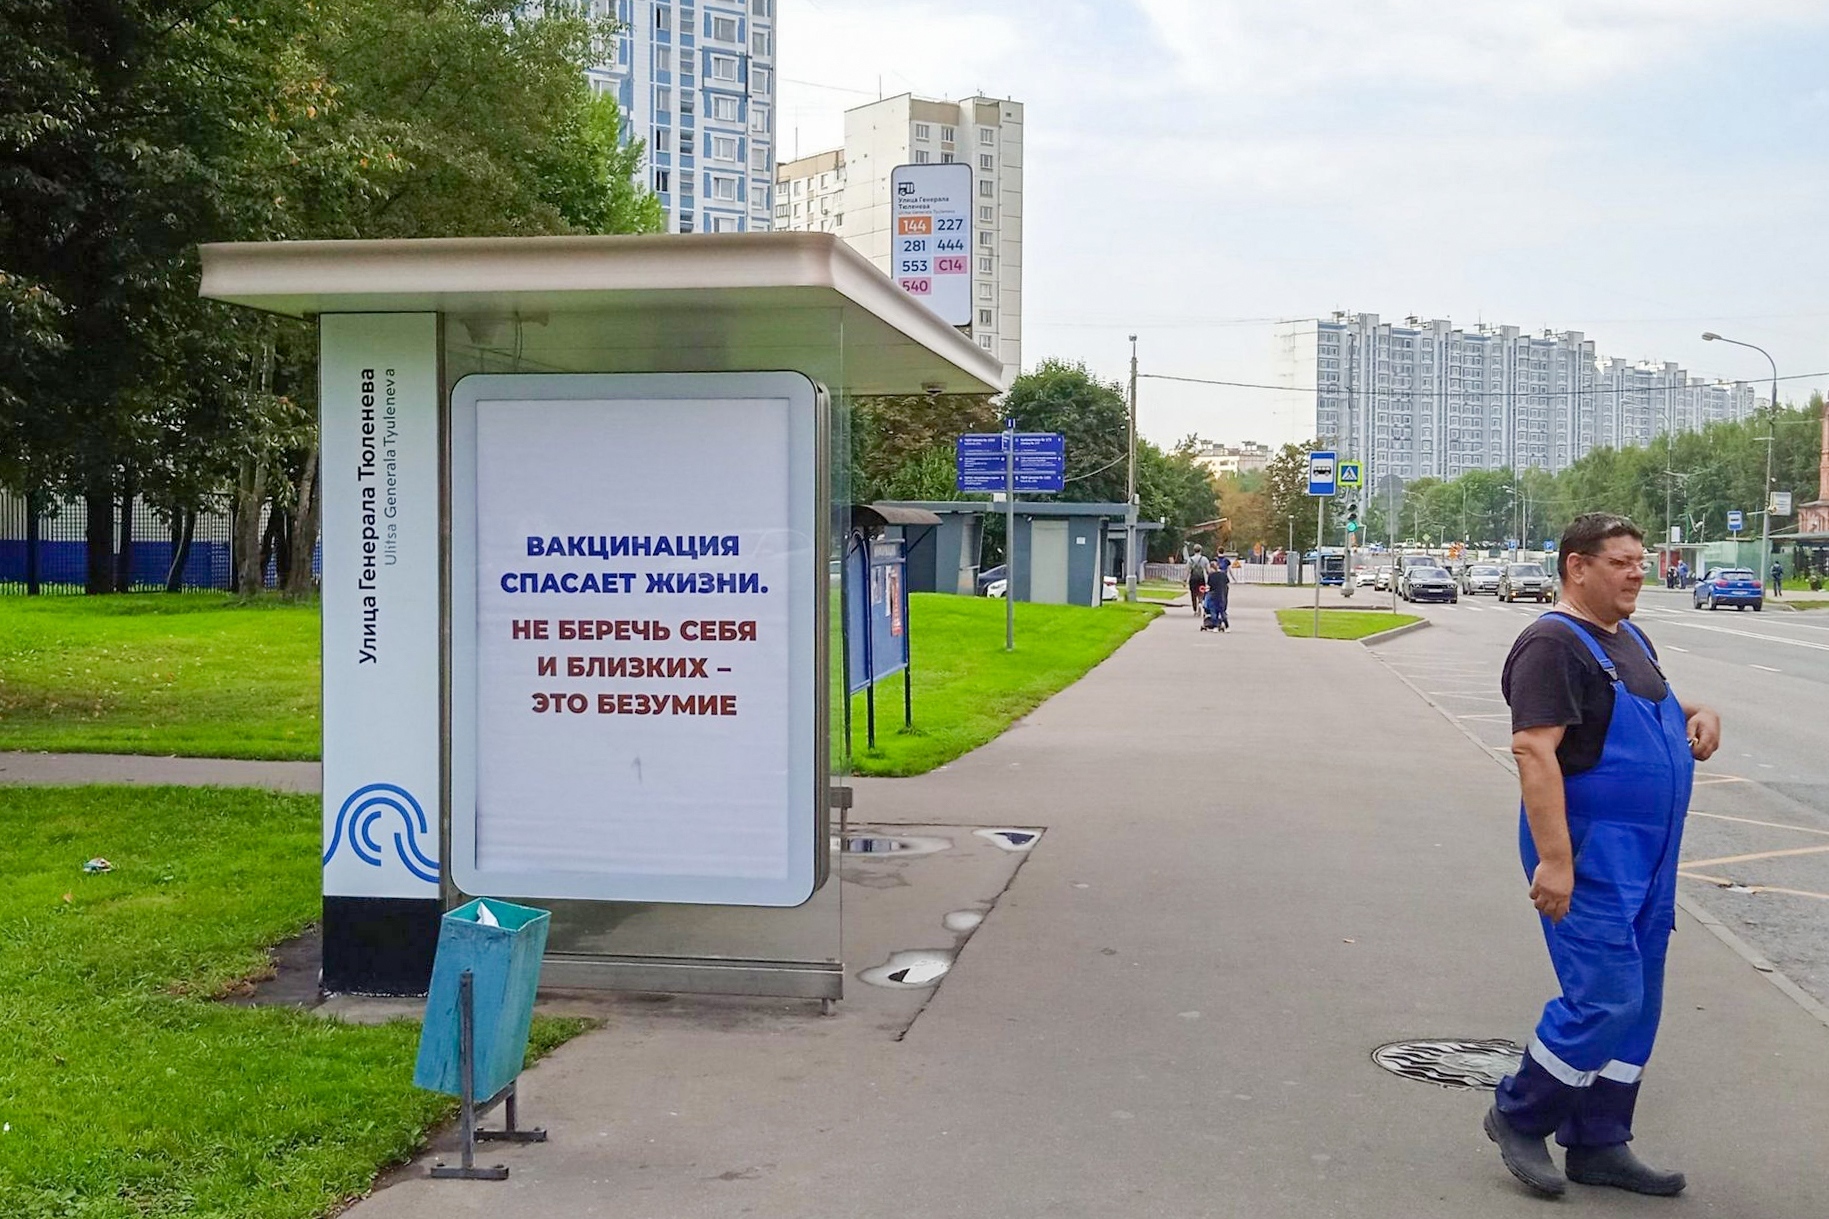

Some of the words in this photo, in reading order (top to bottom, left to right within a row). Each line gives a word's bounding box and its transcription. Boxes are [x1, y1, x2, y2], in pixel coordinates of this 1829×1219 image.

[903, 219, 927, 232] 144
[937, 219, 963, 231] 227
[904, 240, 926, 252] 281
[937, 239, 964, 251] 444
[902, 260, 928, 272] 553
[383, 368, 399, 447] Tyuleneva
[357, 368, 376, 481] Тюленева
[384, 449, 398, 517] Generala
[358, 486, 380, 590] Генерала
[384, 523, 398, 565] Ulitsa
[526, 535, 739, 560] ВАКЦИНАЦИЯ
[500, 572, 636, 594] СПАСАЕТ
[645, 572, 769, 594] ЖИЗНИ.
[359, 596, 379, 664] Улица
[511, 619, 549, 640] НЕ
[558, 619, 671, 641] БЕРЕЧЬ
[680, 619, 757, 641] СЕБЯ
[537, 656, 556, 677] И
[567, 656, 709, 679] БЛИЗКИХ
[531, 692, 588, 714] ЭТО
[597, 693, 737, 716] БЕЗУМИЕ
